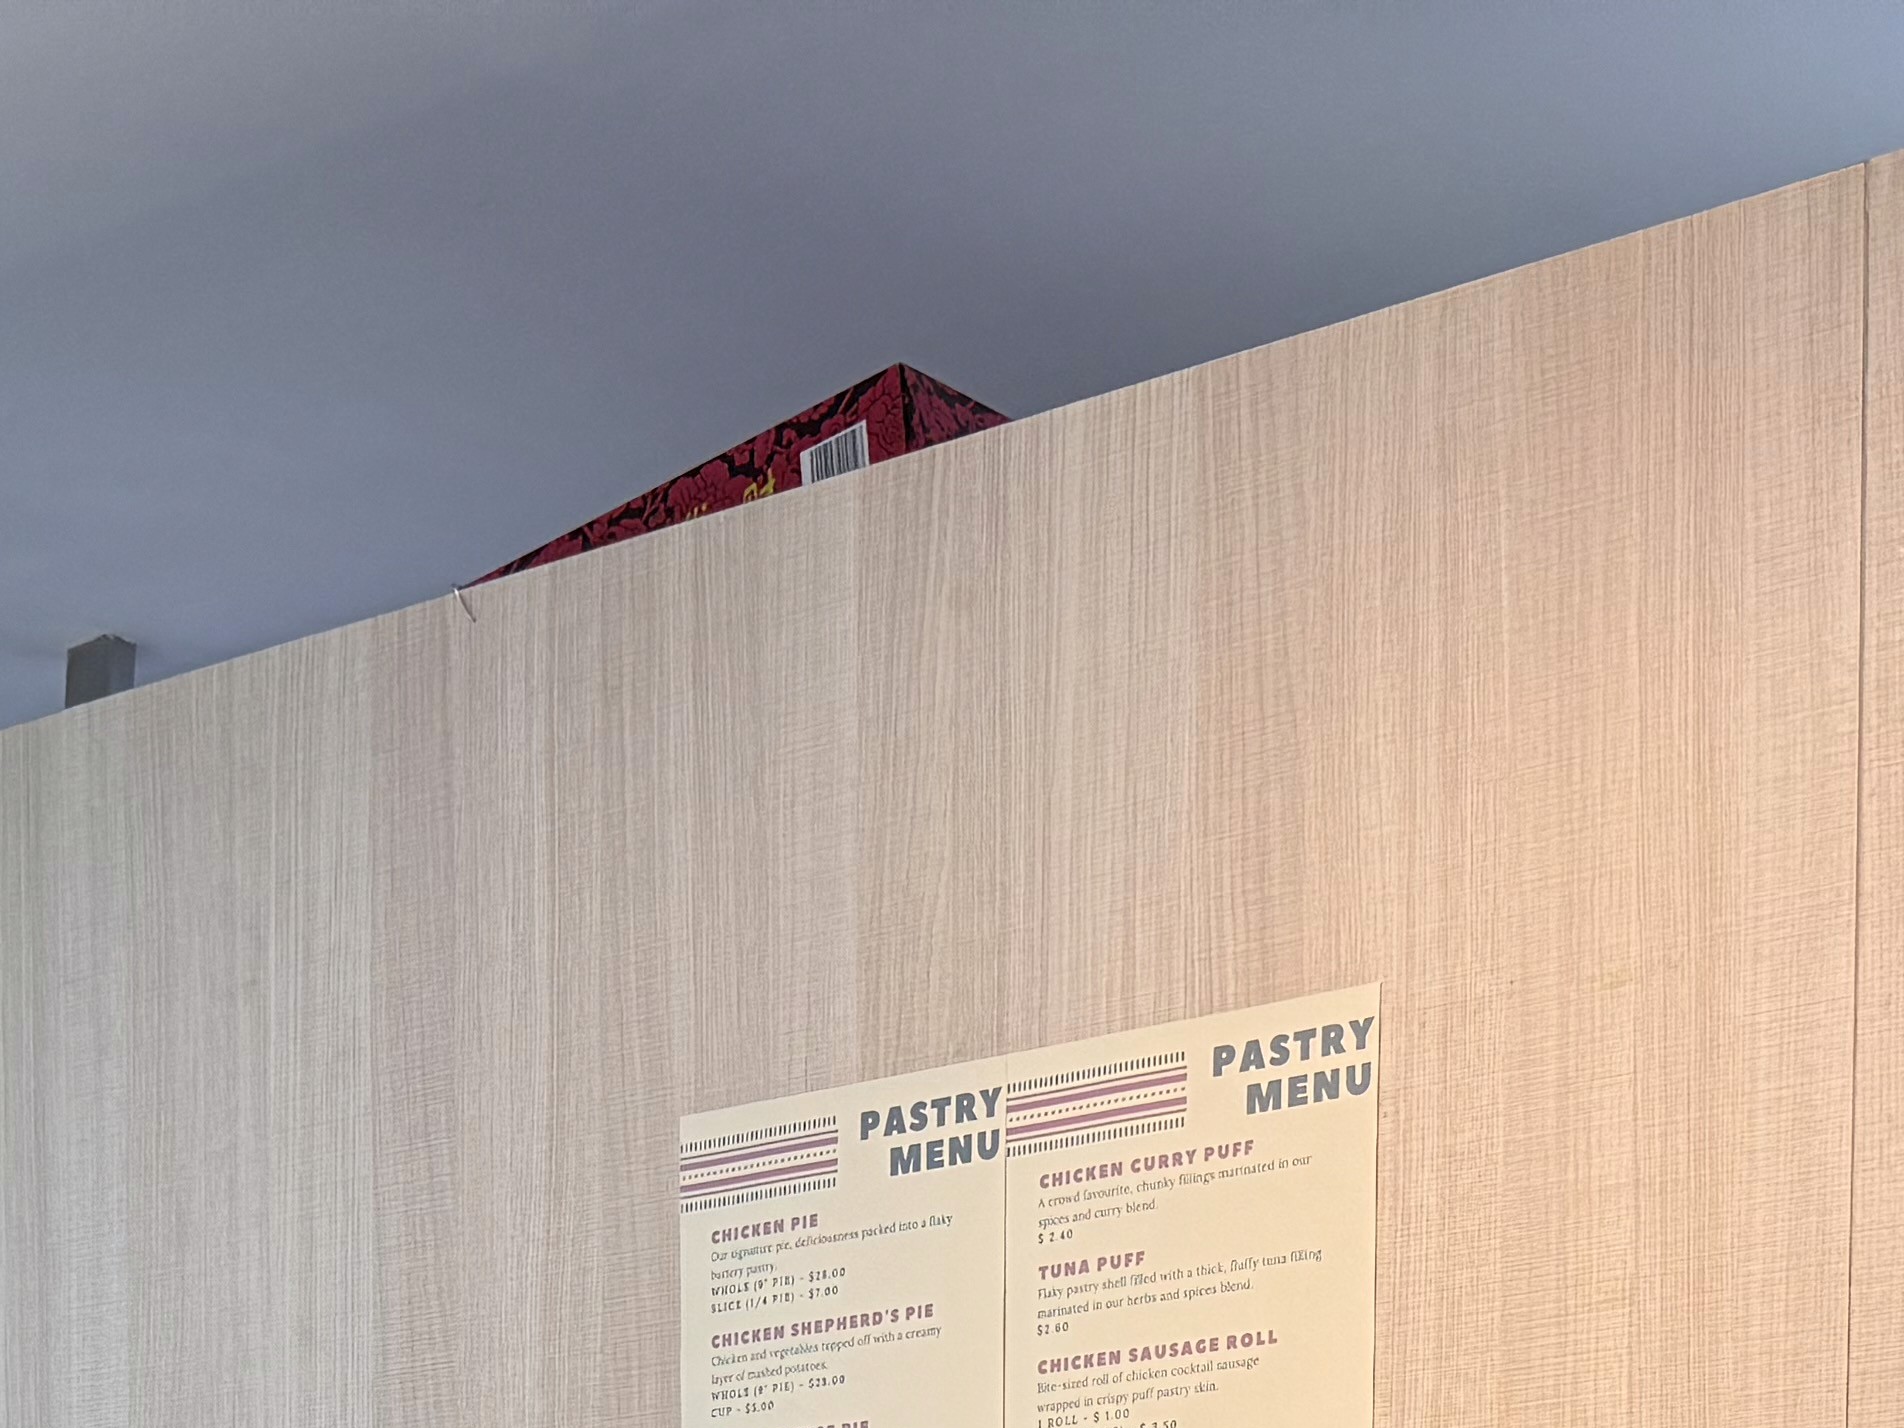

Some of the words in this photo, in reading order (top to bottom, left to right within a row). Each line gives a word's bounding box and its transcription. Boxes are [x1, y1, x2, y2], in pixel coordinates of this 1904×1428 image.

[1212, 1016, 1374, 1077] PASTRY
[1246, 1062, 1372, 1116] MENU
[860, 1086, 1002, 1141] PASTRY
[889, 1128, 1001, 1177] MENU
[1040, 1162, 1123, 1188] CHICKEN
[1130, 1150, 1196, 1173] CURRY
[1204, 1140, 1254, 1161] PUFF
[1048, 1192, 1080, 1207] crowd
[1083, 1186, 1133, 1200] favourite,
[1137, 1178, 1175, 1192] chunky
[1218, 1161, 1274, 1179] marinated
[1278, 1160, 1288, 1169] in
[1292, 1156, 1312, 1166] our
[711, 1218, 784, 1244] CHICKEN
[791, 1214, 818, 1230] PIE
[1072, 1210, 1091, 1222] and
[1095, 1205, 1122, 1219] curry
[1038, 1234, 1044, 1244] $
[1038, 1259, 1089, 1280] TUNA
[1097, 1251, 1145, 1272] PUFF
[1067, 1283, 1098, 1298] pastry
[1102, 1276, 1126, 1289] shell
[1160, 1268, 1184, 1282] with
[1187, 1270, 1192, 1278] a
[1196, 1264, 1226, 1276] thick,
[1230, 1258, 1259, 1272] fluffy
[1262, 1254, 1286, 1266] tuna
[1038, 1301, 1089, 1319] marinated
[1093, 1299, 1102, 1310] in
[1106, 1298, 1124, 1308] our
[1127, 1293, 1156, 1306] herbs
[1160, 1288, 1180, 1302] and
[1183, 1285, 1216, 1300] spices
[711, 1325, 785, 1349] CHICKEN
[791, 1308, 899, 1337] SHEPHERD'S
[906, 1304, 934, 1321] PIE
[874, 1332, 895, 1344] with
[1038, 1350, 1121, 1374] CHICKEN
[1128, 1338, 1219, 1362] SAUSAGE
[1226, 1330, 1278, 1350] ROLL
[1038, 1377, 1088, 1394] Bite-sized
[1092, 1374, 1108, 1386] roll
[1112, 1372, 1123, 1383] of
[1126, 1368, 1168, 1382] chicken
[1170, 1361, 1214, 1376] cocktail
[1217, 1356, 1259, 1370] sausage
[711, 1407, 732, 1417] CUP
[1037, 1398, 1080, 1413] wrapped
[1084, 1396, 1093, 1406] in
[1096, 1392, 1128, 1406] crispy
[1132, 1388, 1154, 1402] puff
[1157, 1385, 1190, 1400] pastry
[1048, 1414, 1078, 1428] ROLL
[1094, 1412, 1099, 1422] $
[1105, 1409, 1130, 1421] 1.00
